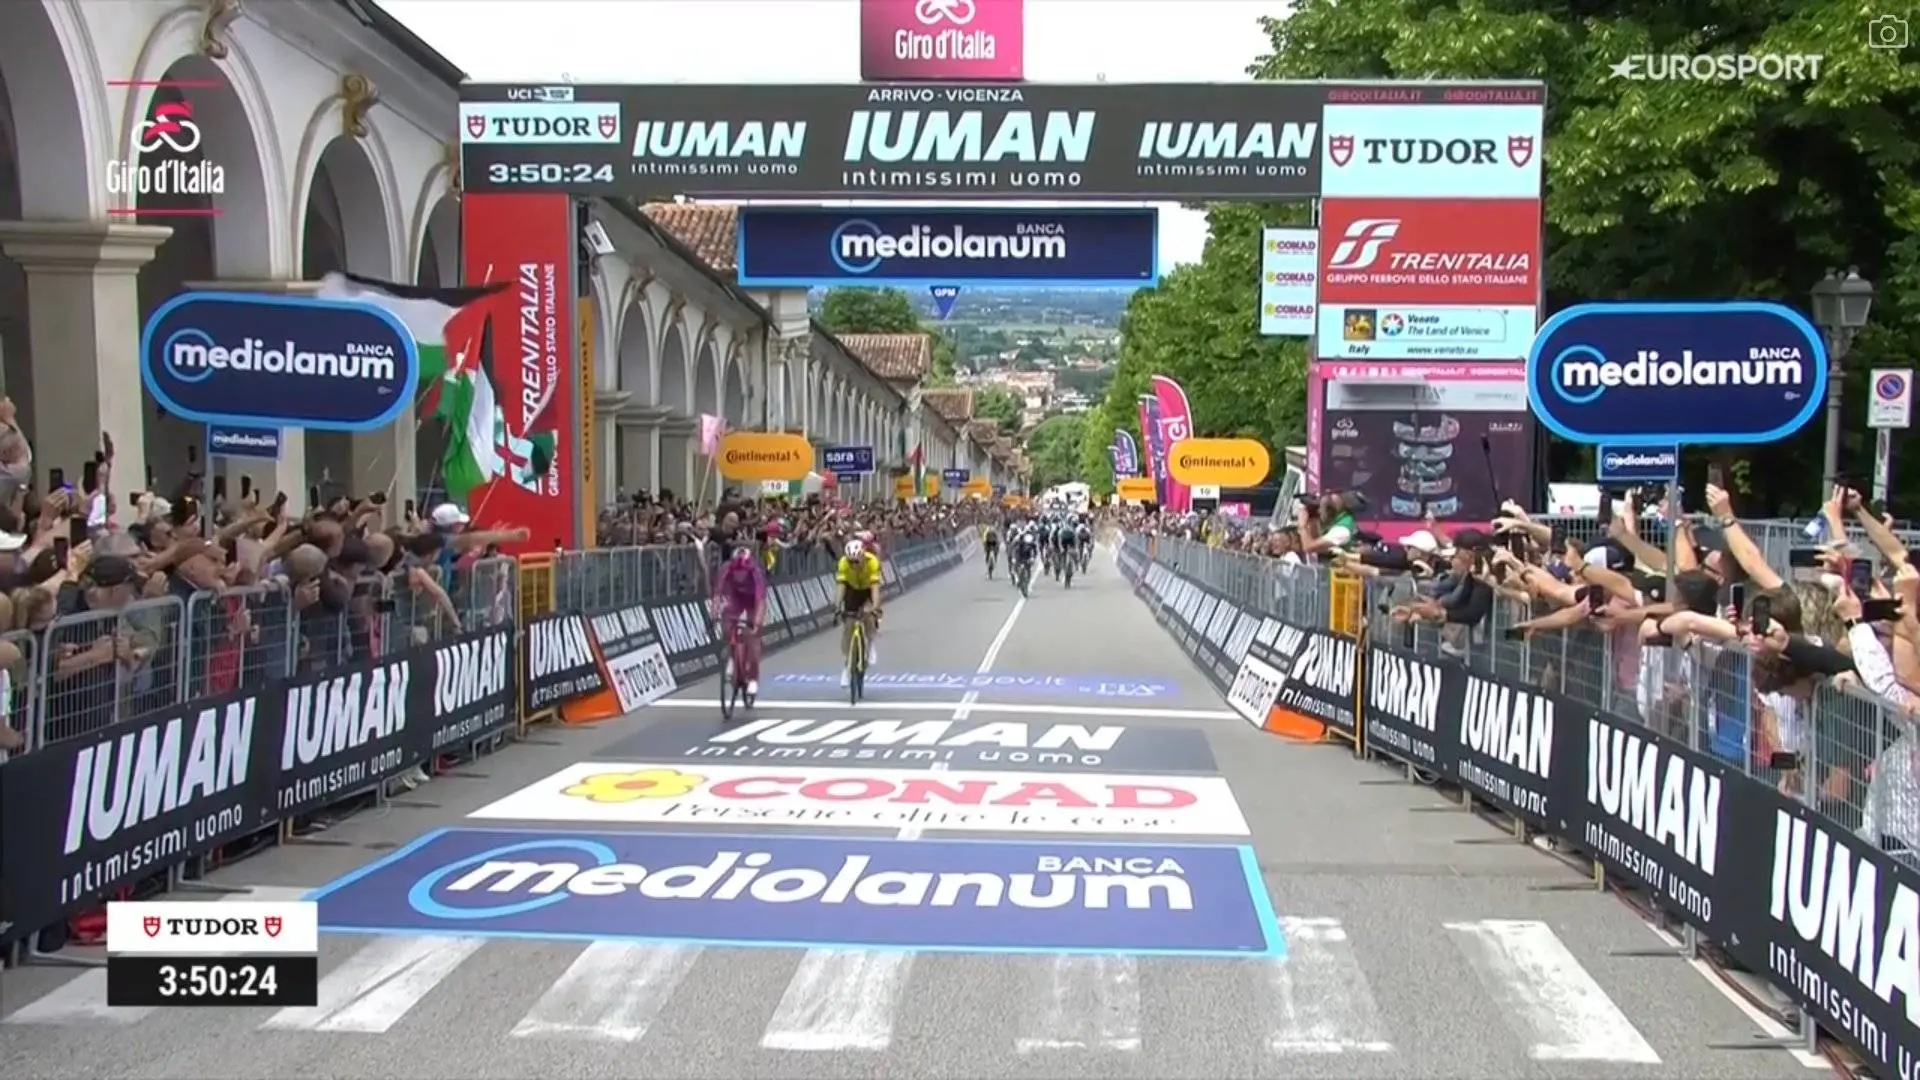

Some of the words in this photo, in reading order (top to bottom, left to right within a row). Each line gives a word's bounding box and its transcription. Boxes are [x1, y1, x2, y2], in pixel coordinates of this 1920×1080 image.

[895, 29, 932, 59] Giro
[935, 29, 995, 59] d'Italia
[507, 88, 532, 100] UCI
[868, 88, 934, 102] ARRIVO
[946, 88, 1024, 102] VICENZA
[492, 116, 591, 137] TUDOR
[632, 121, 807, 157] IUMAN
[844, 111, 1096, 162] IUMAN
[1138, 122, 1318, 159] IUMAN
[1364, 138, 1498, 165] TUDOR
[488, 163, 614, 183] 3:50:24
[631, 162, 739, 176] intimissimi
[747, 164, 798, 175] uomo
[842, 168, 996, 186] intimissimi
[1010, 171, 1082, 187] uomo
[1137, 163, 1247, 177] intimissimi
[1256, 165, 1307, 177] uomo
[842, 225, 1065, 259] mediolanum
[1017, 223, 1065, 234] BANCA
[1391, 252, 1530, 270] TRENITALIA
[1327, 273, 1368, 284] GRUPPO
[1370, 273, 1416, 284] FERROVIE
[1418, 273, 1449, 284] DELLO
[1452, 273, 1482, 284] STATO
[1485, 273, 1528, 285] ITALIANE
[1407, 325, 1424, 336] The
[1426, 325, 1447, 336] Land
[1448, 325, 1459, 336] of
[1461, 325, 1490, 336] Venice
[172, 337, 394, 381] mediolanum
[346, 342, 394, 356] BANCA
[1348, 344, 1370, 355] Italy
[1750, 347, 1801, 359] BANCA
[1563, 351, 1801, 387] mediolanum
[726, 449, 791, 463] Continental
[826, 452, 854, 463] sara
[1180, 455, 1246, 469] Continental
[529, 615, 594, 681] IUMAN
[434, 631, 507, 718] IUMAN
[1370, 647, 1441, 732] IUMAN
[281, 660, 409, 771] IUMAN
[432, 713, 481, 749] intimissimi
[483, 702, 505, 730] uomo
[1460, 676, 1553, 779] IUMAN
[709, 718, 1125, 751] IUMAN
[1413, 734, 1435, 762] uomo
[685, 745, 953, 761] intimissimi
[980, 751, 1103, 766] uomo
[64, 698, 255, 854] IUMAN
[278, 761, 366, 809] intimissimi
[370, 746, 402, 775] uomo
[709, 776, 1198, 808] CONAD
[1458, 759, 1511, 801] intimissimi
[1587, 719, 1721, 876] IUMAN
[61, 825, 187, 904] intimissimi
[195, 803, 243, 842] uomo
[1037, 855, 1185, 875] BANCA
[448, 853, 1193, 911] mediolanum
[1585, 820, 1664, 889] intimissimi
[1668, 874, 1712, 923] uomo
[1769, 809, 1920, 1024] IUMA
[1768, 941, 1888, 1063] intimissimi
